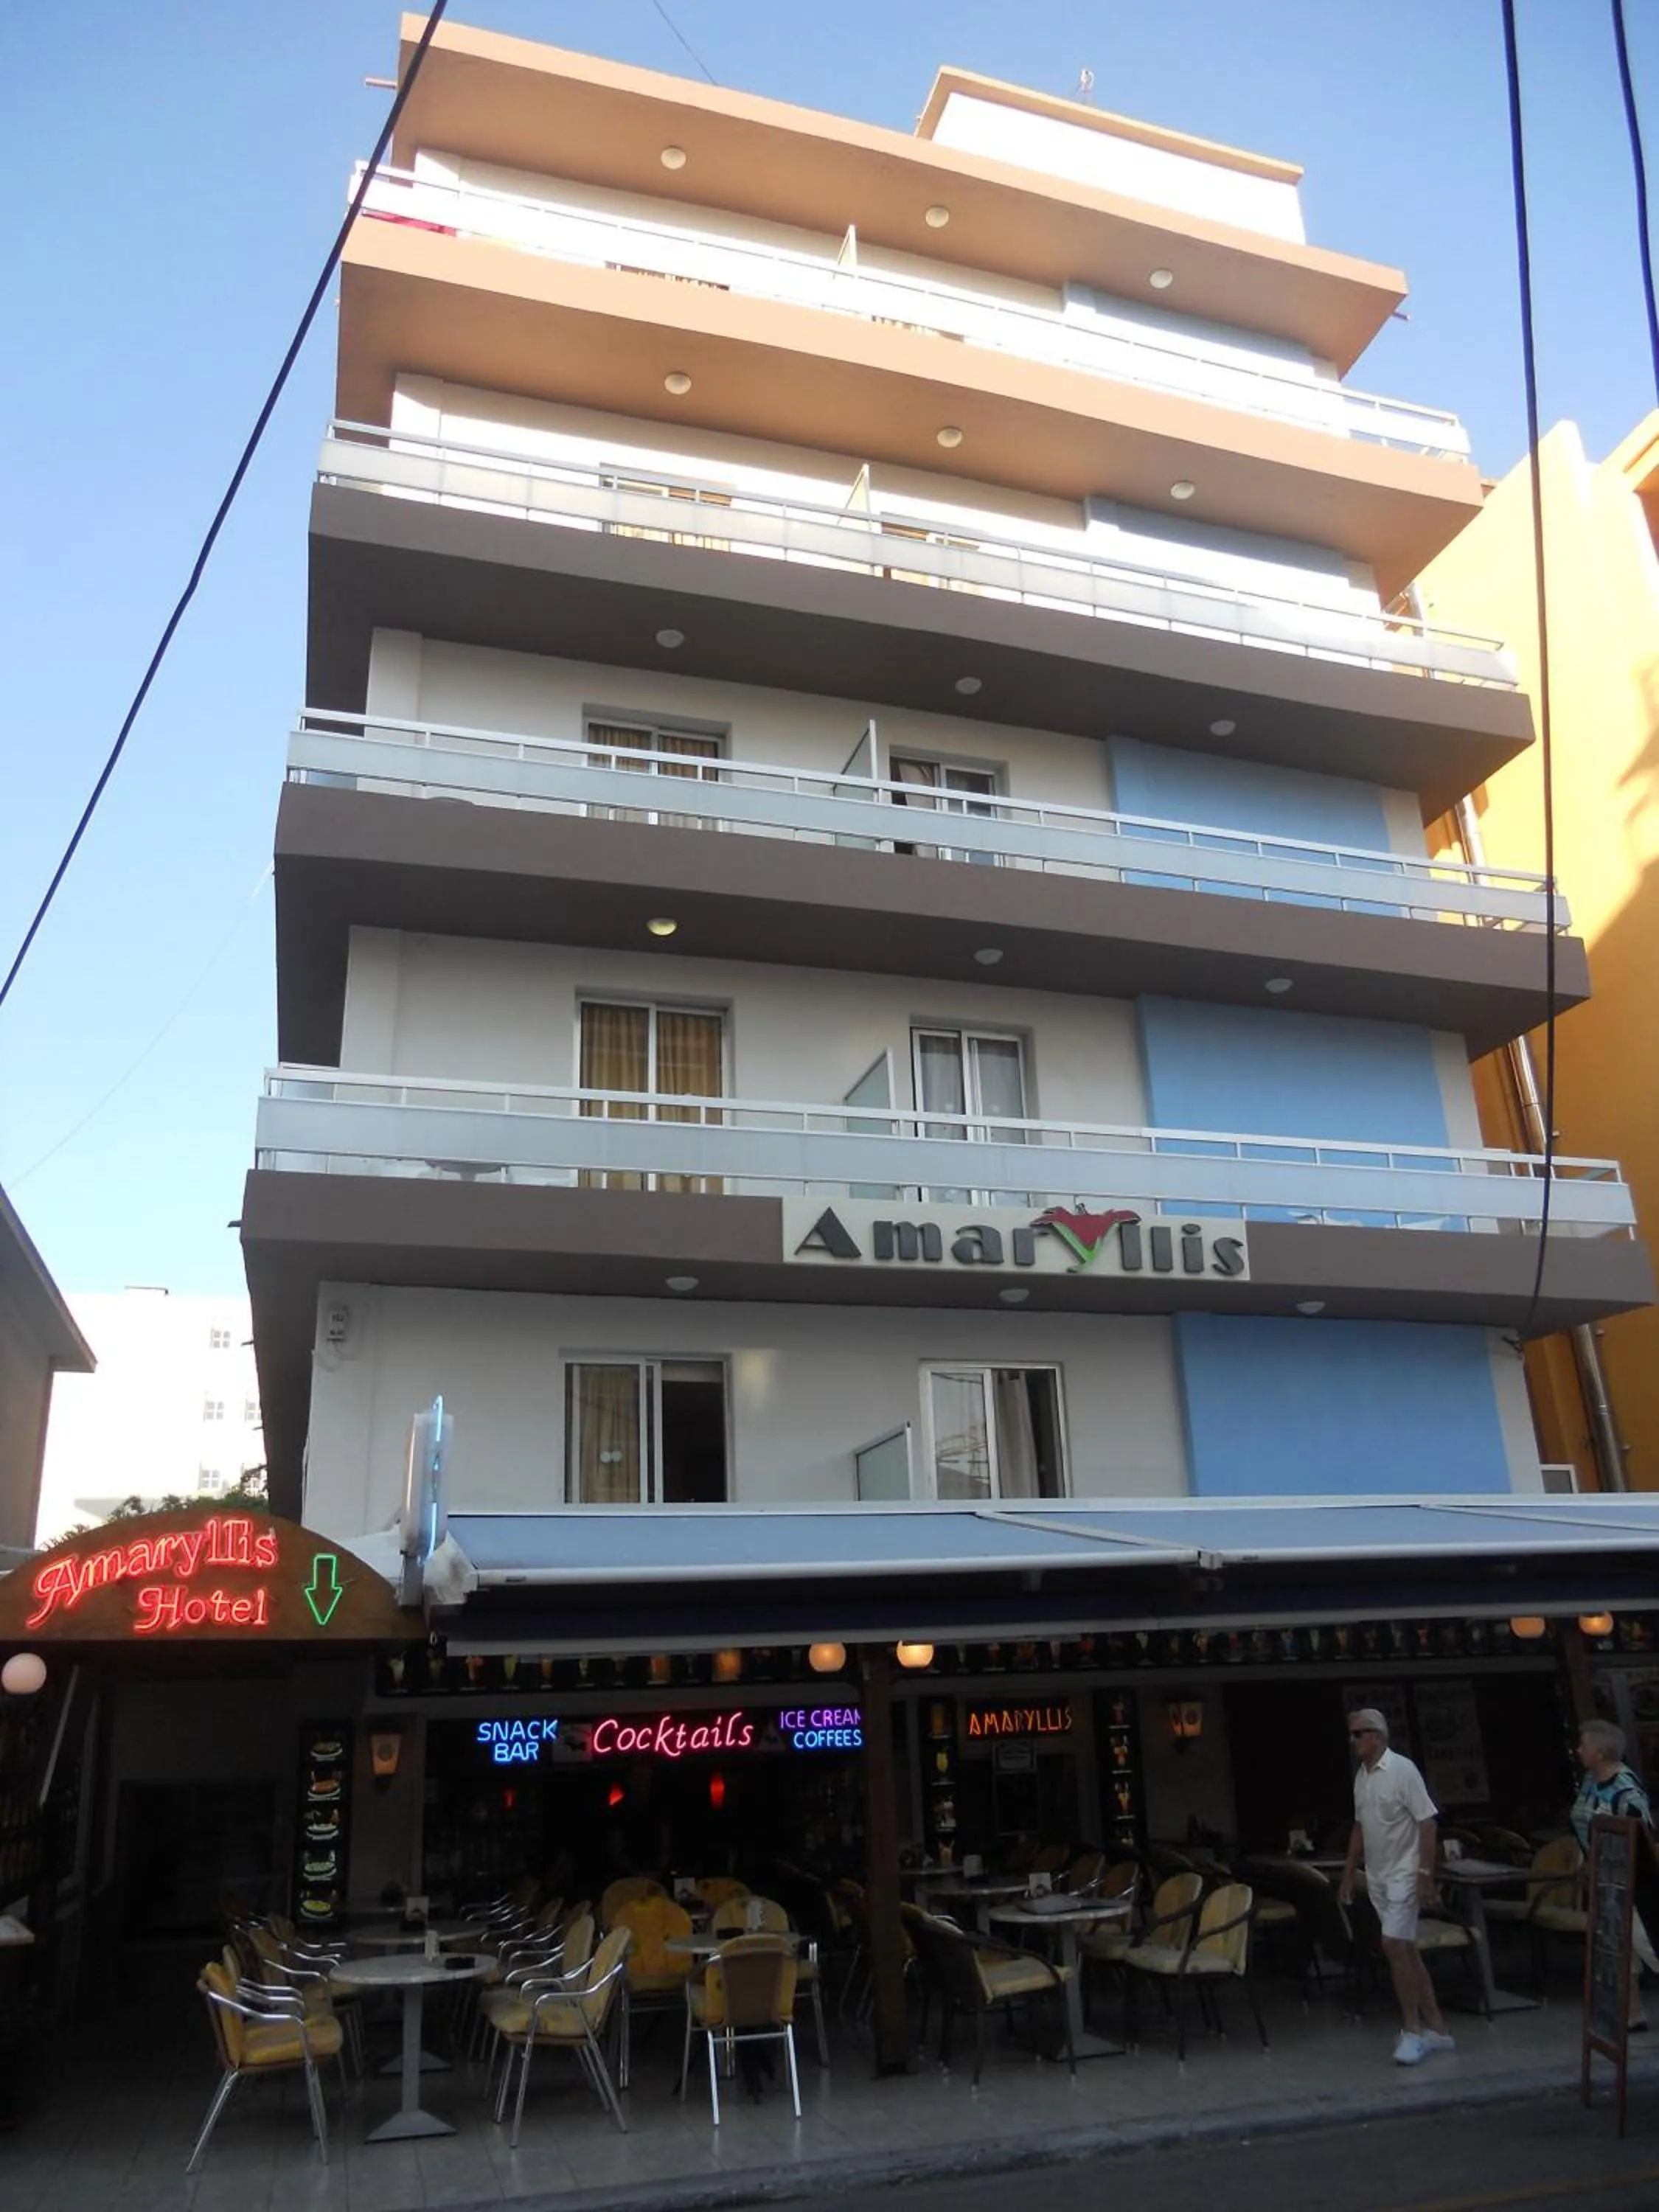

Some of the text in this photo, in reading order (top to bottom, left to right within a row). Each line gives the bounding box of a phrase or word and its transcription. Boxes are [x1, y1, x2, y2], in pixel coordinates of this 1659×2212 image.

[793, 1203, 1245, 1277] Amaryllis
[24, 1516, 278, 1631] Amaryllis
[133, 1585, 271, 1633] Hotel
[476, 1718, 559, 1742] SNACK
[592, 1711, 755, 1757] Cocktails
[779, 1709, 806, 1730] ICE
[968, 1704, 1074, 1736] AMARYLLIS
[493, 1740, 540, 1763] BAR
[793, 1728, 863, 1750] COFFEES
